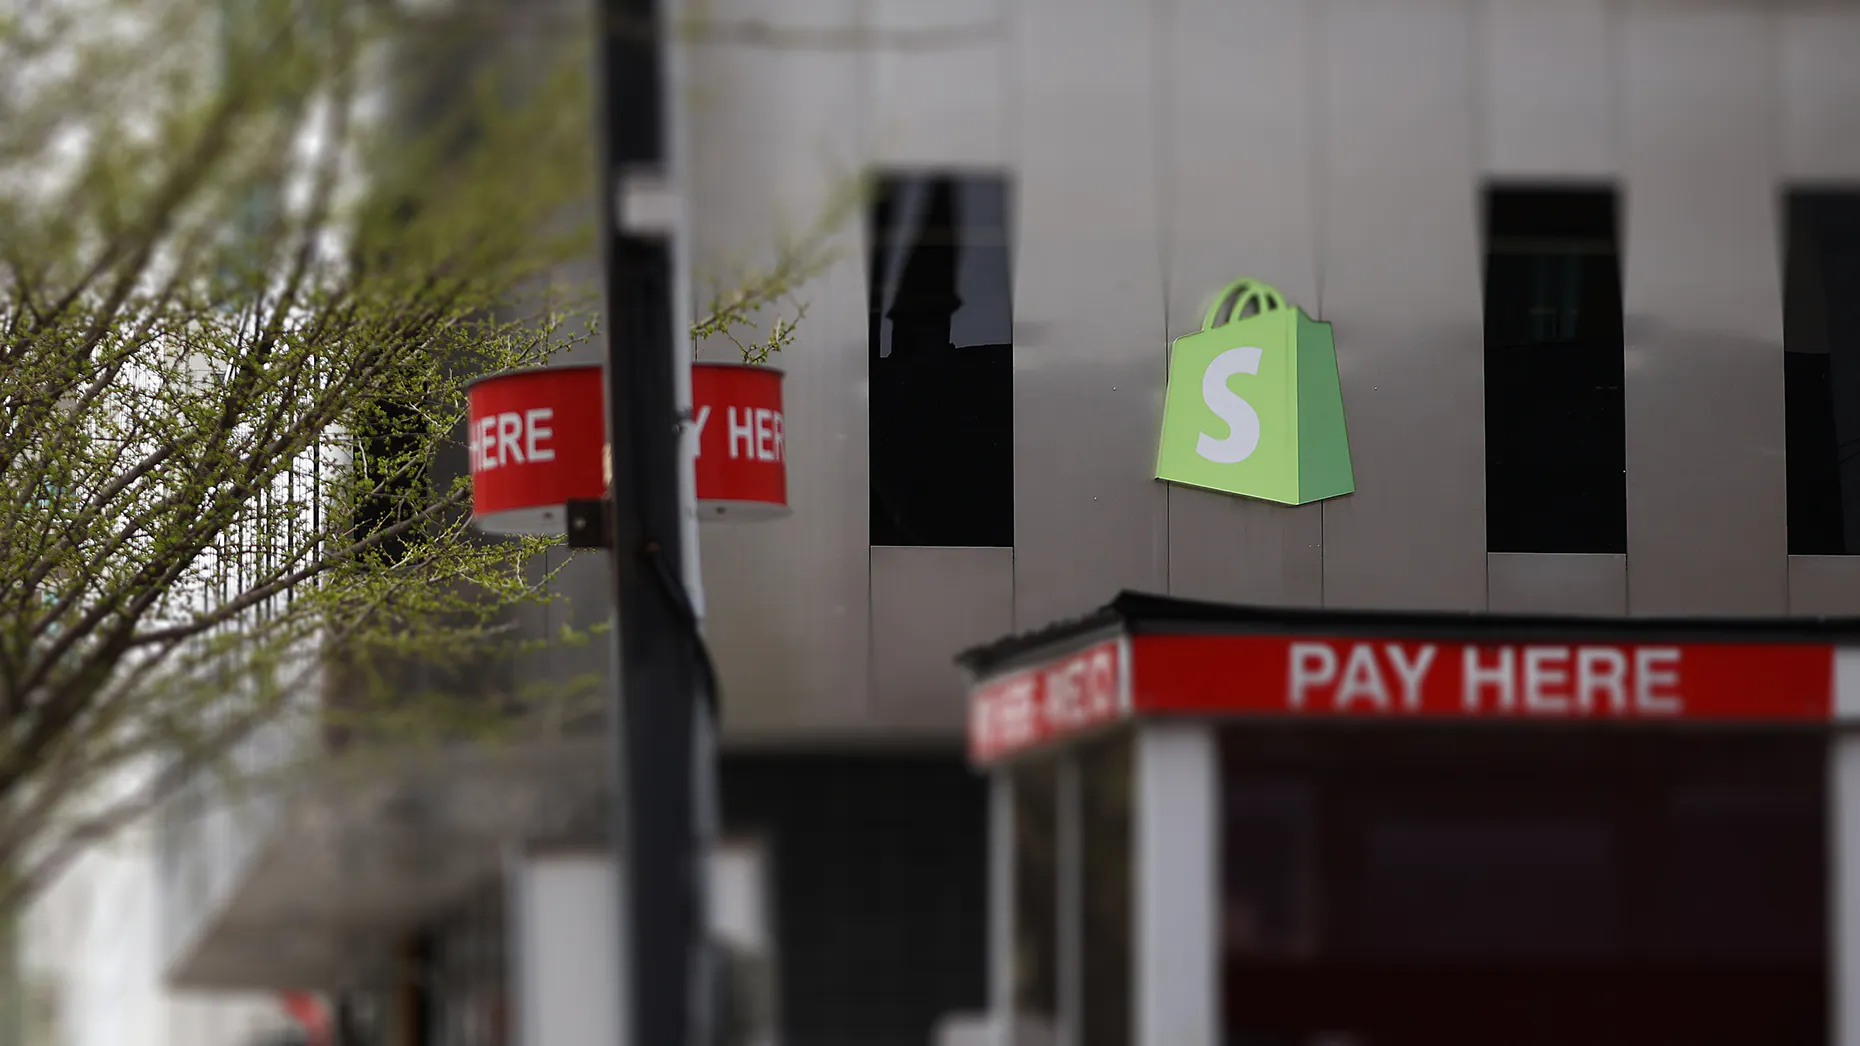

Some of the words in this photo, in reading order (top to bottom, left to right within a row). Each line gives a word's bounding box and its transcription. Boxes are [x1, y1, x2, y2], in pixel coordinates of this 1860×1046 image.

[471, 407, 556, 472] HERE
[1196, 346, 1263, 464] S
[1288, 641, 1437, 710] PAY
[1462, 645, 1683, 713] HERE
